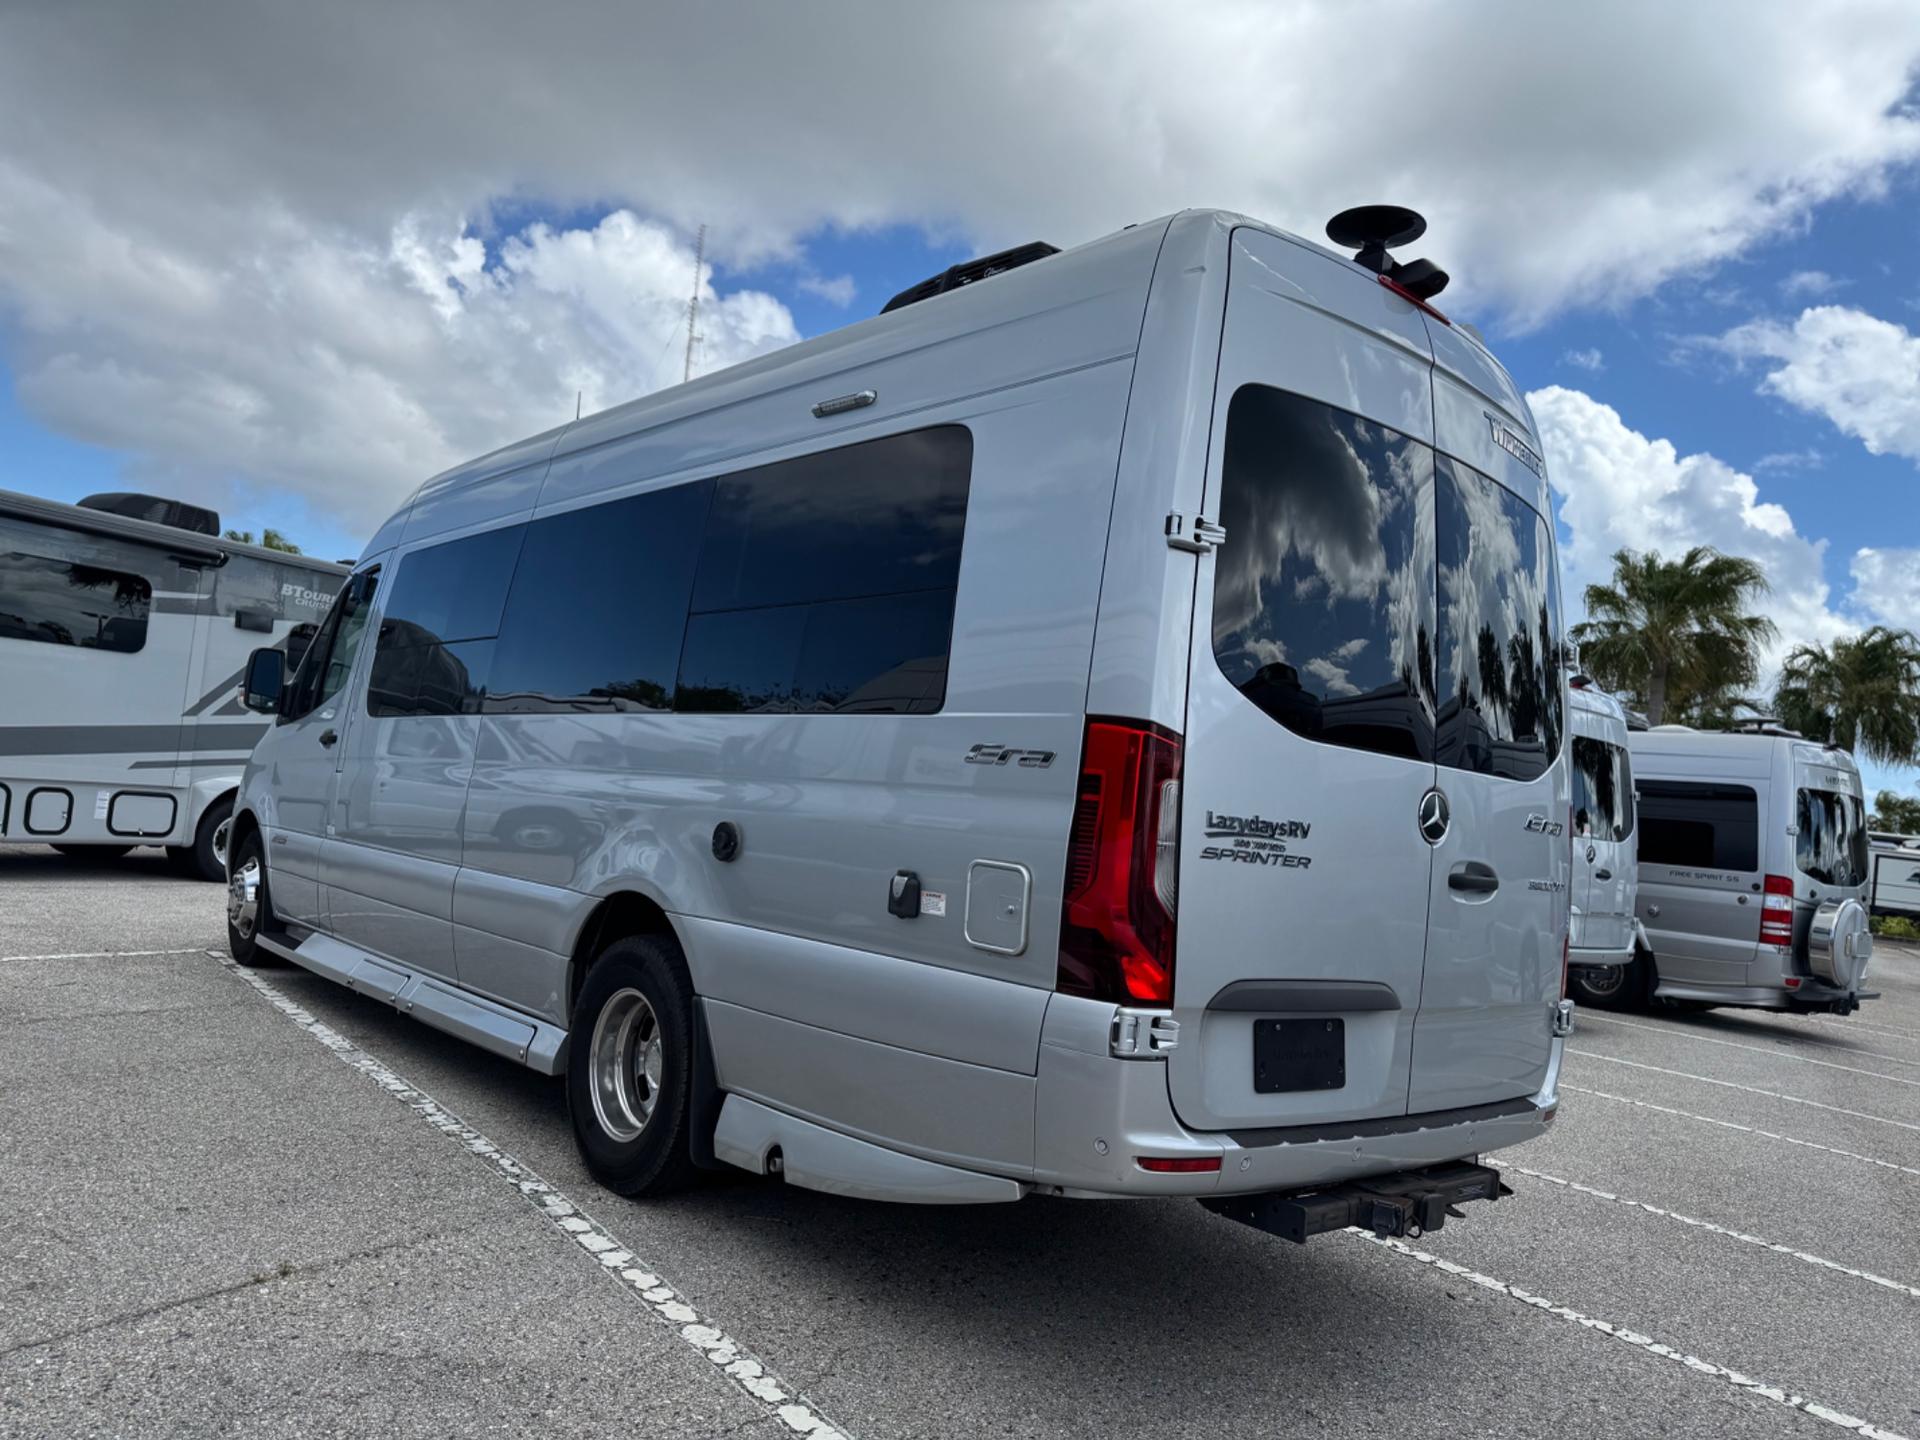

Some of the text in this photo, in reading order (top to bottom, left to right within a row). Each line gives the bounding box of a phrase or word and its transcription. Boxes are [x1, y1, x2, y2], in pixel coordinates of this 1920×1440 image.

[295, 597, 331, 610] CRUISE
[964, 743, 1057, 769] Era
[1200, 846, 1312, 869] SPRINTER
